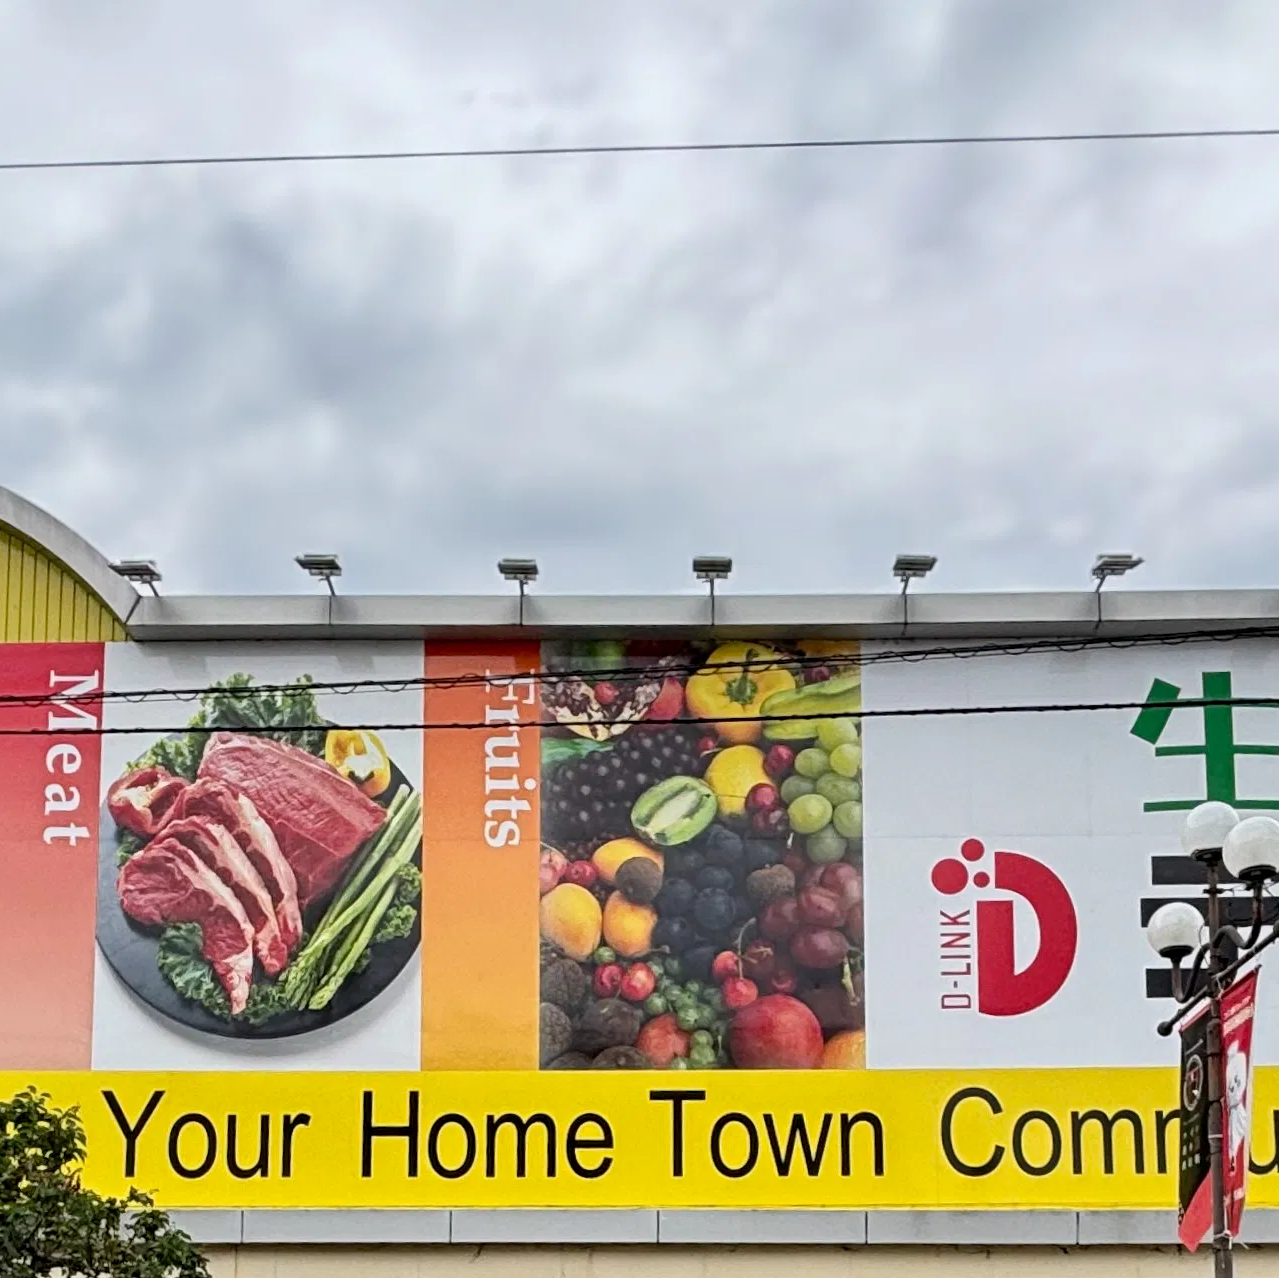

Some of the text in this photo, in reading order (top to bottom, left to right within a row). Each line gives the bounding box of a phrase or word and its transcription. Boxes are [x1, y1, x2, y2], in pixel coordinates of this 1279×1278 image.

[43, 668, 100, 847] Meat
[483, 668, 537, 848] Fruits
[939, 907, 972, 1011] D-LINK
[101, 1089, 312, 1179] Your
[360, 1089, 615, 1180] Home
[648, 1089, 885, 1179] Town
